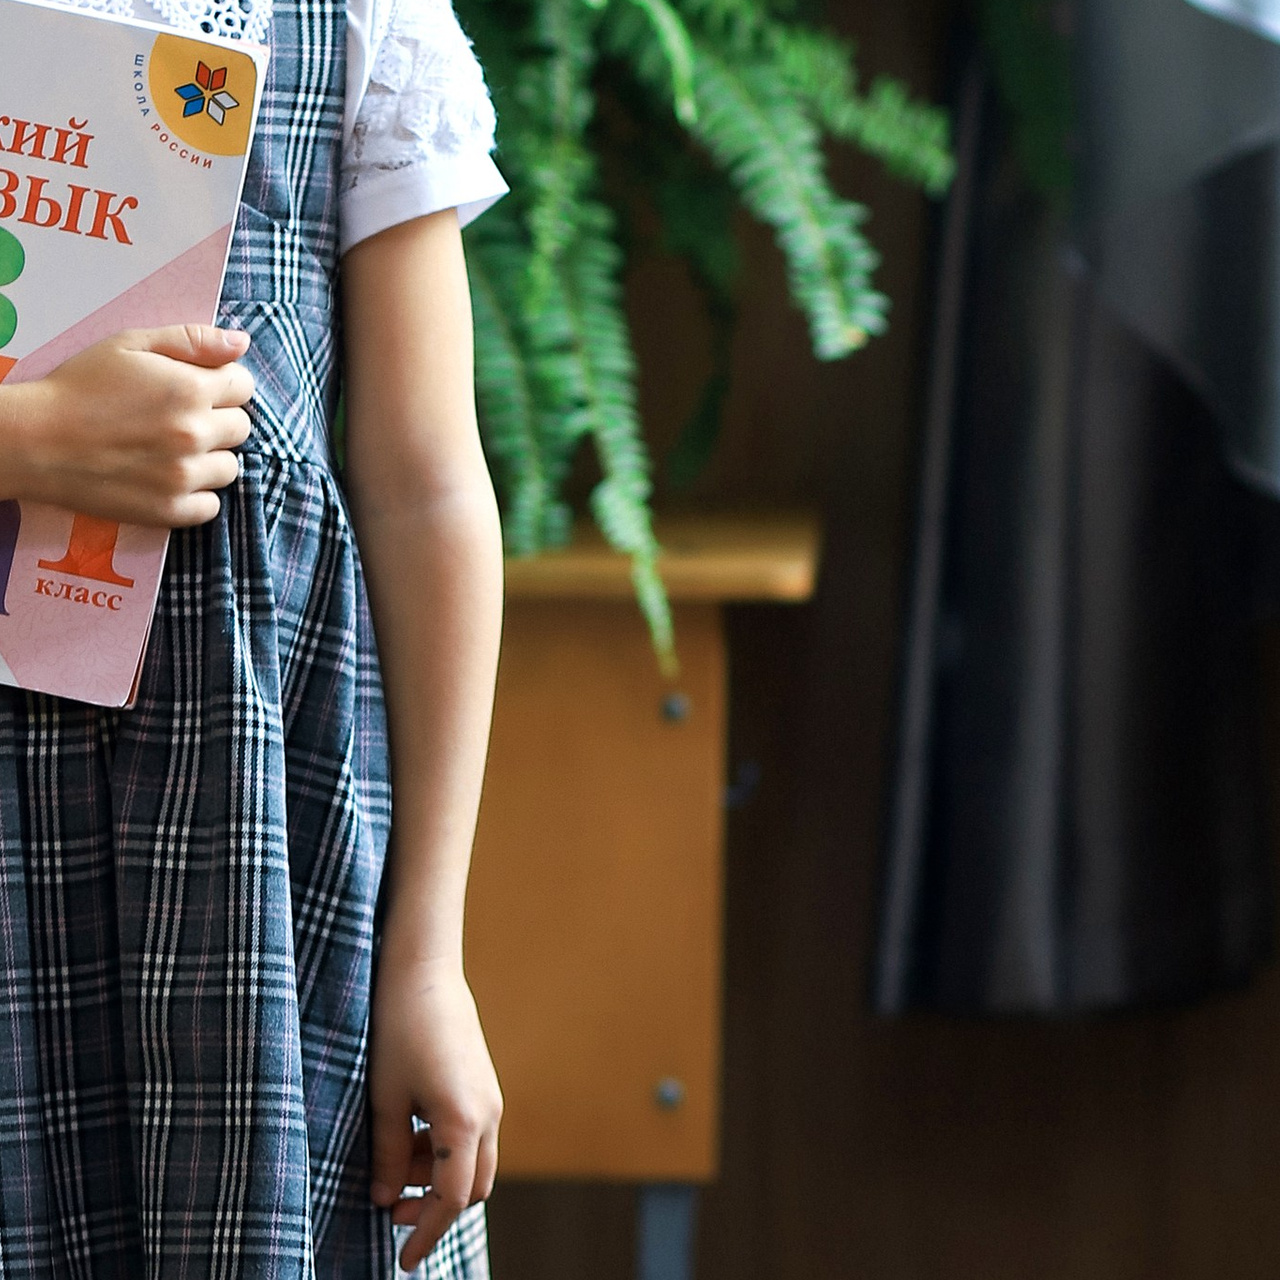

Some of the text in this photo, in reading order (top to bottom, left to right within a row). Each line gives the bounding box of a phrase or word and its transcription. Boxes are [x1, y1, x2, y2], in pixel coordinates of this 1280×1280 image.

[133, 54, 213, 169] ШКОЛА РОССИИ
[34, 577, 123, 612] класс
